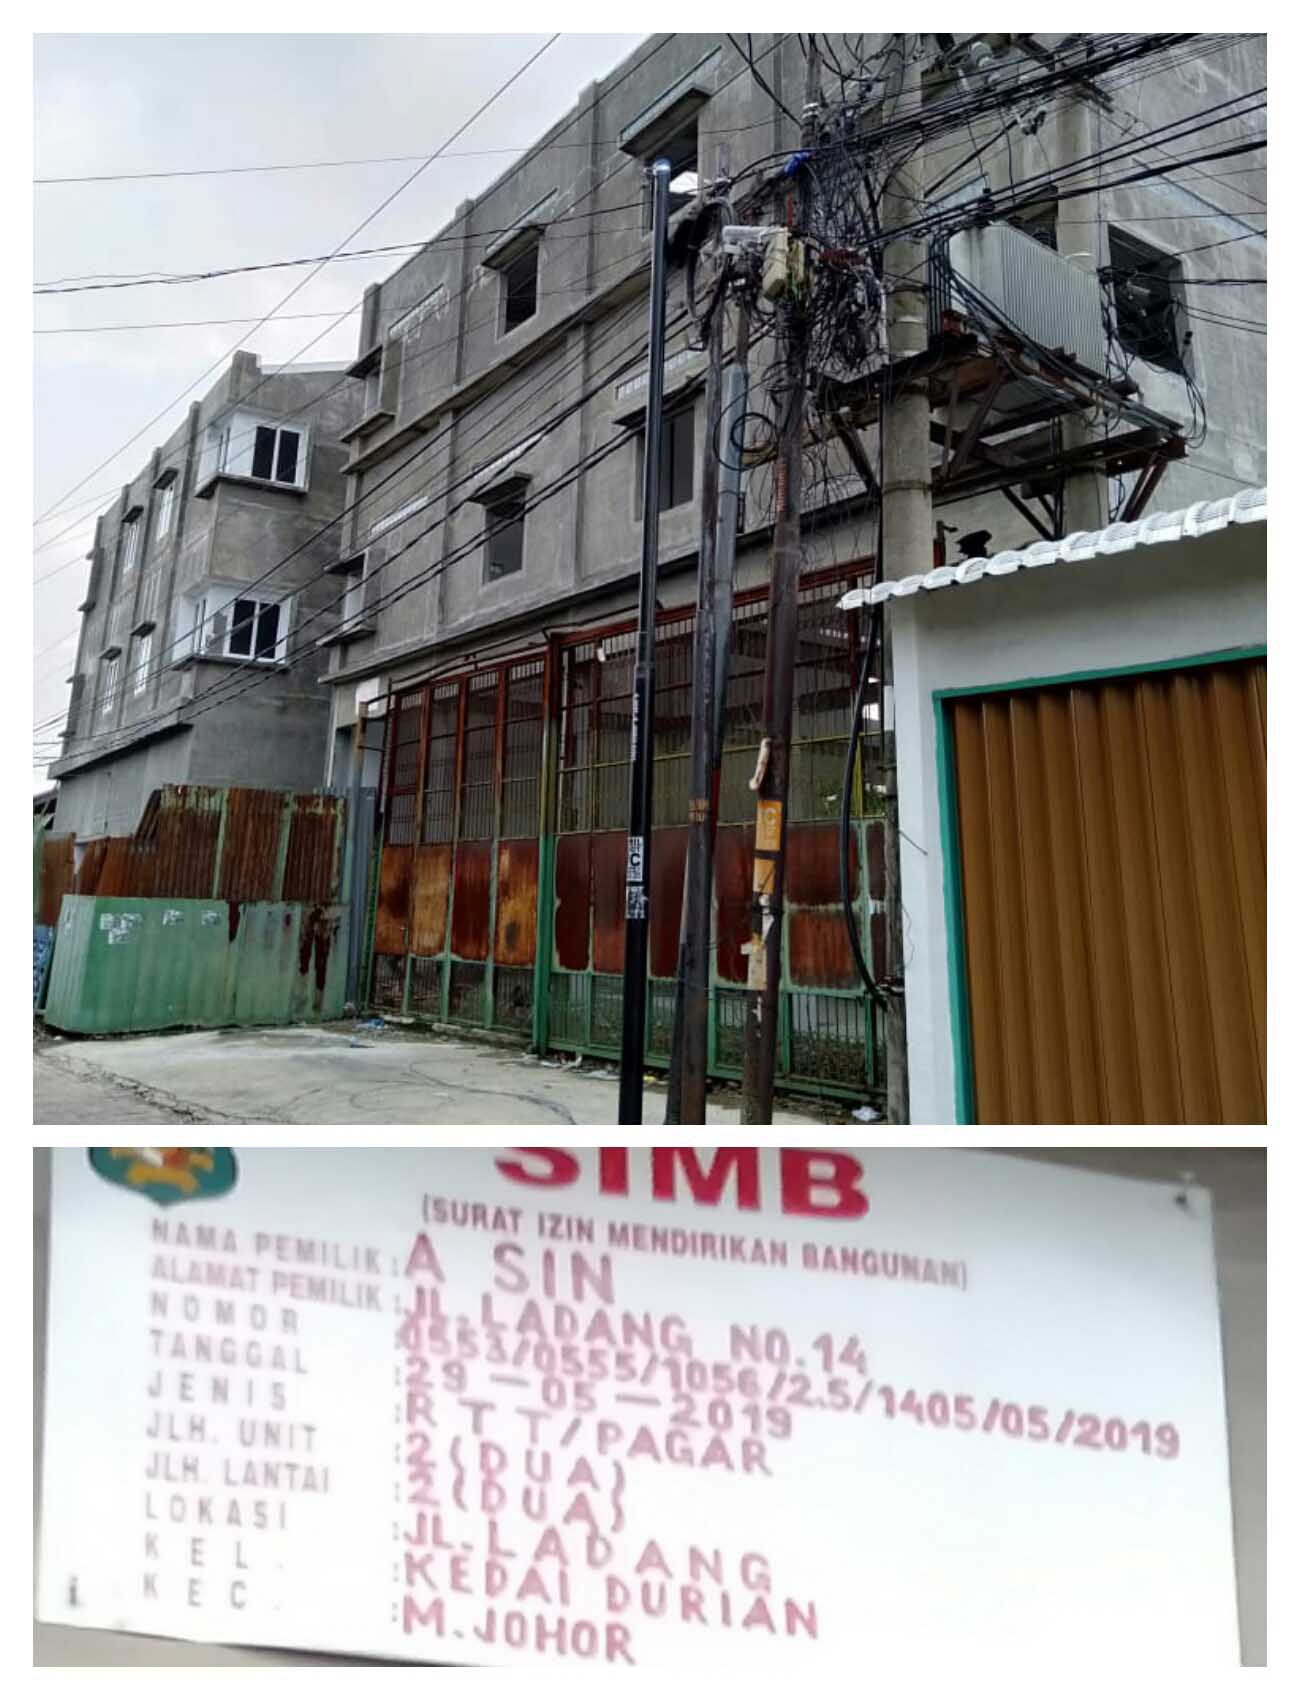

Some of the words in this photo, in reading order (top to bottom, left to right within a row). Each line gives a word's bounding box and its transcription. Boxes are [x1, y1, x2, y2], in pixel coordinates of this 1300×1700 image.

[151, 1218, 239, 1254] NAMA
[254, 1231, 382, 1275] PEMILIK
[492, 1242, 617, 1306] SIN
[422, 1194, 523, 1234] (SURAT
[537, 1211, 595, 1244] IZIN
[607, 1222, 789, 1268] MENDIRIKAN
[802, 1246, 969, 1292] BANGUNAN)
[150, 1254, 259, 1292] ALAMAT
[271, 1269, 383, 1313] PEMILIK
[150, 1291, 299, 1335] NOMOR
[149, 1327, 309, 1375] TANGGAL
[147, 1371, 287, 1412] JENIS
[238, 1418, 319, 1452] UNIT
[223, 1458, 331, 1495] LANTAI
[145, 1491, 287, 1531] LOKASI
[404, 1550, 571, 1607] KEDAI
[606, 1573, 820, 1640] DURIAN
